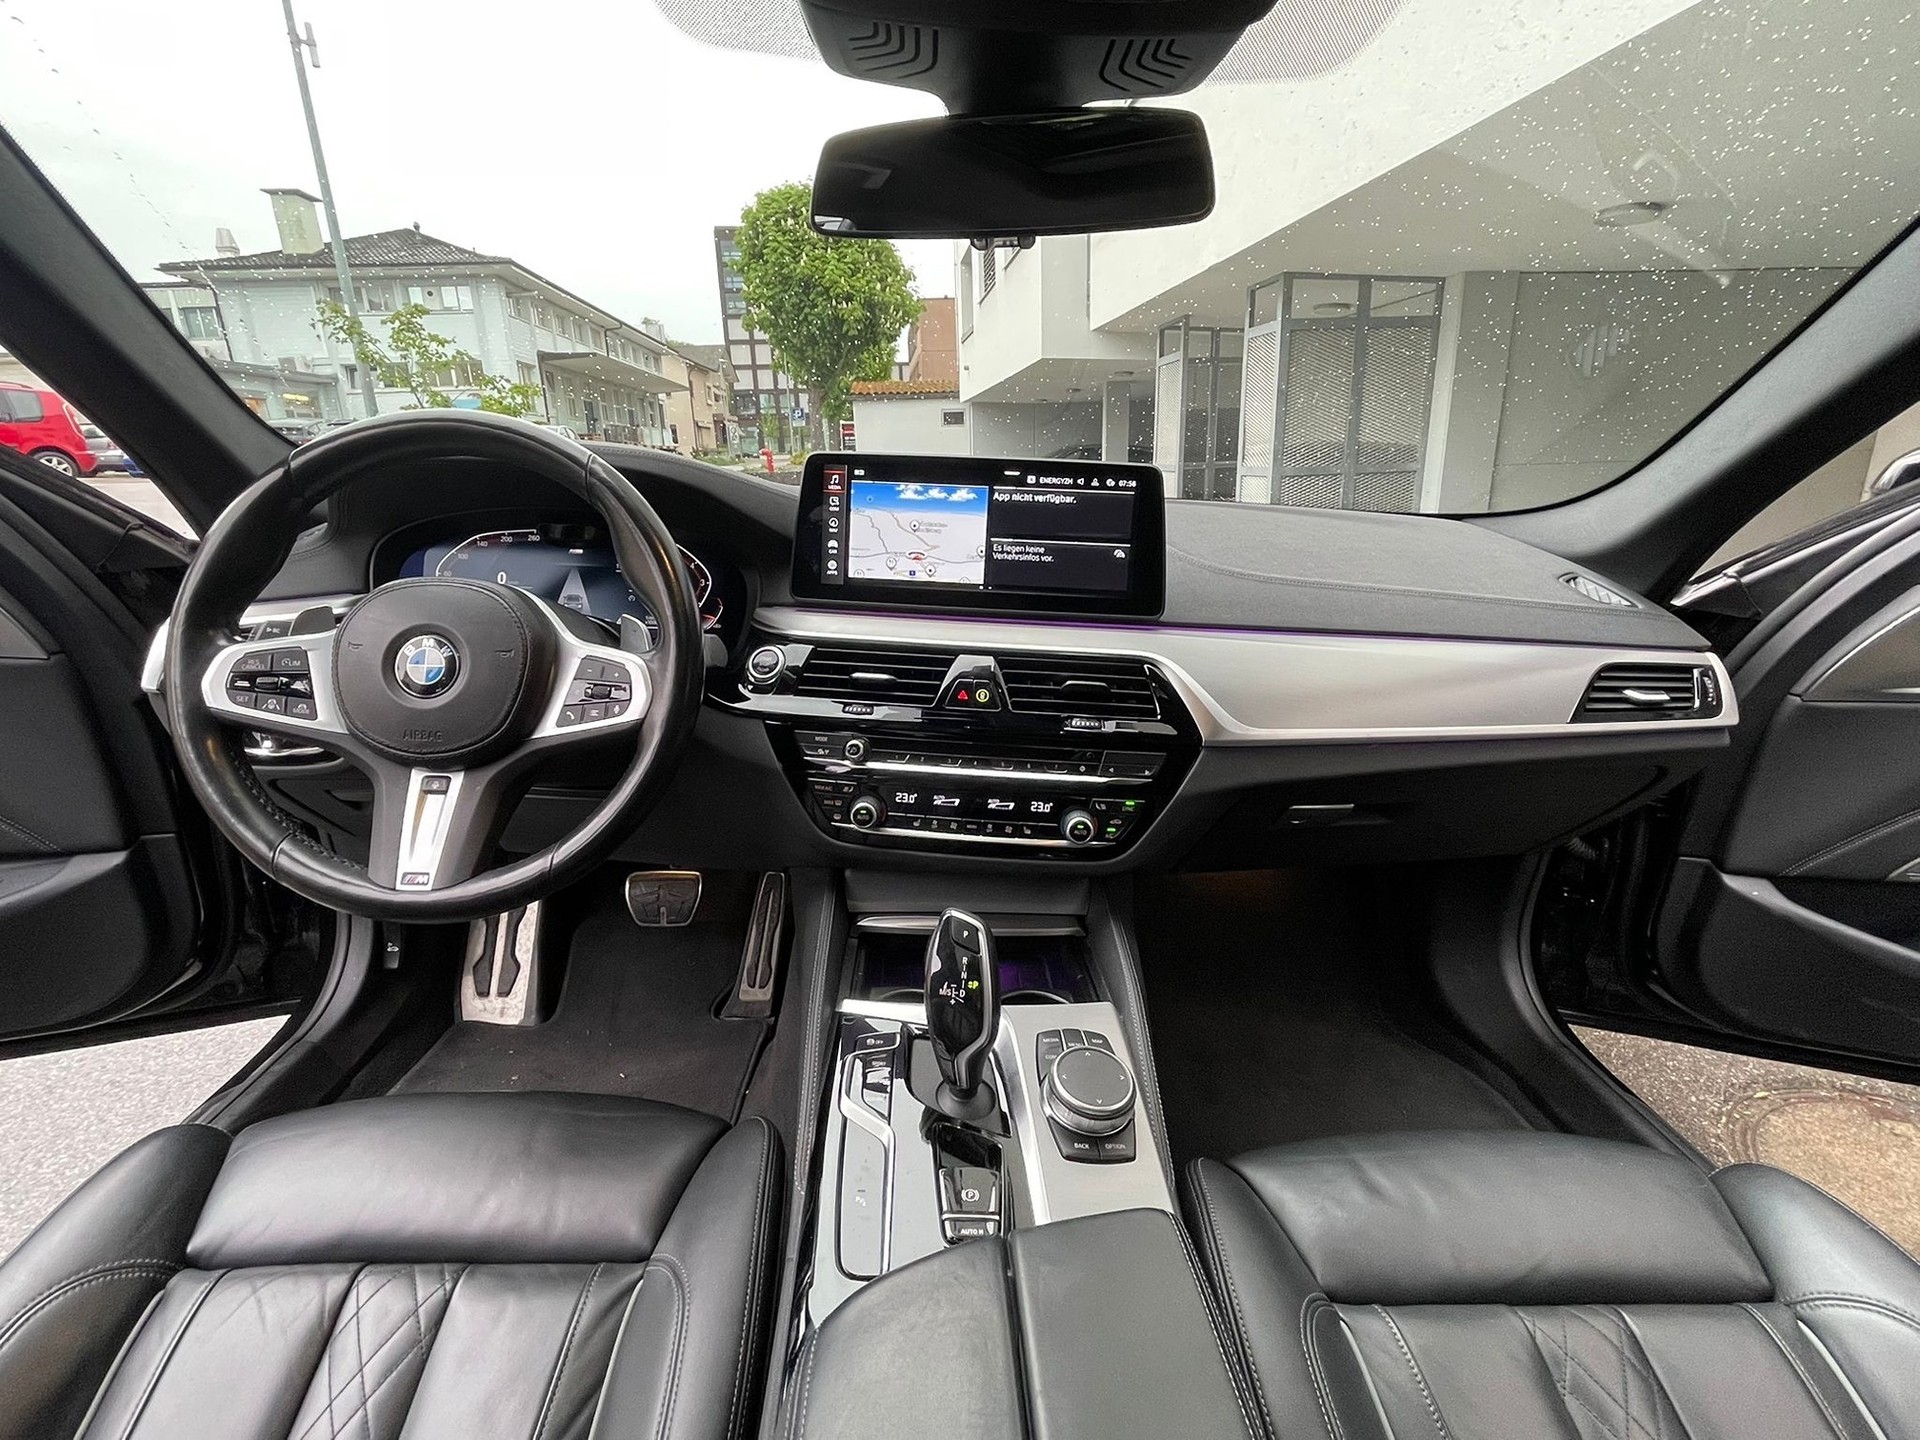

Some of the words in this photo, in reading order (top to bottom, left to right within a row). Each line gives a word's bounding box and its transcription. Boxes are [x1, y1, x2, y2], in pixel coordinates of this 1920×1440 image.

[993, 491, 1010, 502] App
[1011, 492, 1033, 501] nicht
[1034, 494, 1077, 504] verfügbar.
[993, 543, 1002, 551] Es
[1003, 544, 1025, 553] liegen
[1026, 545, 1045, 553] keine
[992, 552, 1040, 561] Verkehrsinfos
[1040, 554, 1054, 562] vor.
[689, 562, 695, 570] 4
[497, 571, 507, 585] 0
[699, 579, 706, 587] 3
[403, 637, 453, 658] BMW
[402, 730, 444, 743] AIRBAG
[963, 930, 969, 938] P
[962, 957, 968, 965] R
[961, 971, 967, 979] N
[959, 990, 966, 998] D
